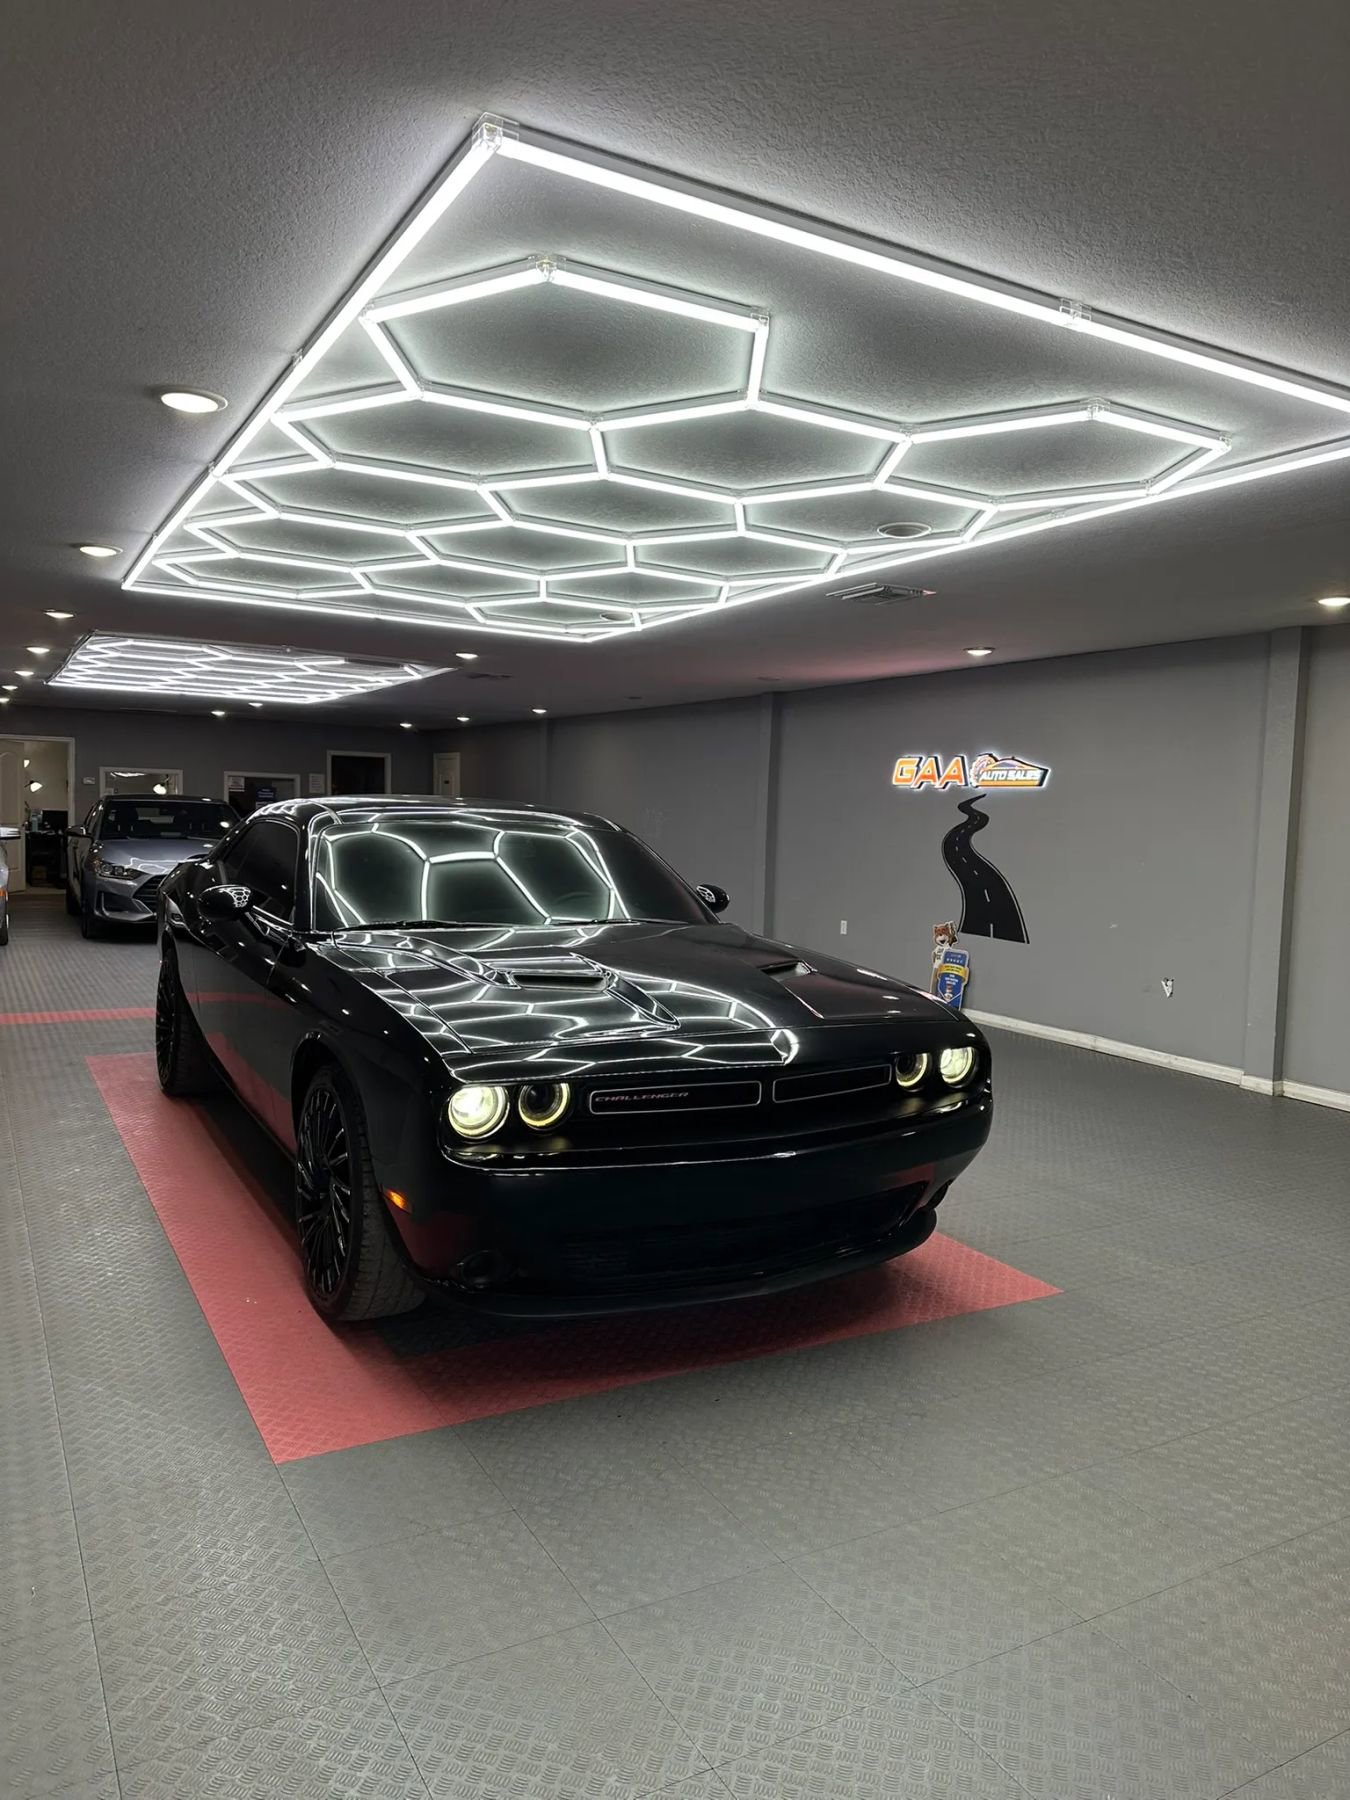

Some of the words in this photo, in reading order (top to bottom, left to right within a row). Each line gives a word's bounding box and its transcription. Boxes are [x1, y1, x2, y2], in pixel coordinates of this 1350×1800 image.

[893, 755, 968, 789] GAA
[980, 769, 1006, 781] AUTO
[1007, 769, 1041, 781] SALES
[595, 1092, 689, 1102] CHALLENGER
